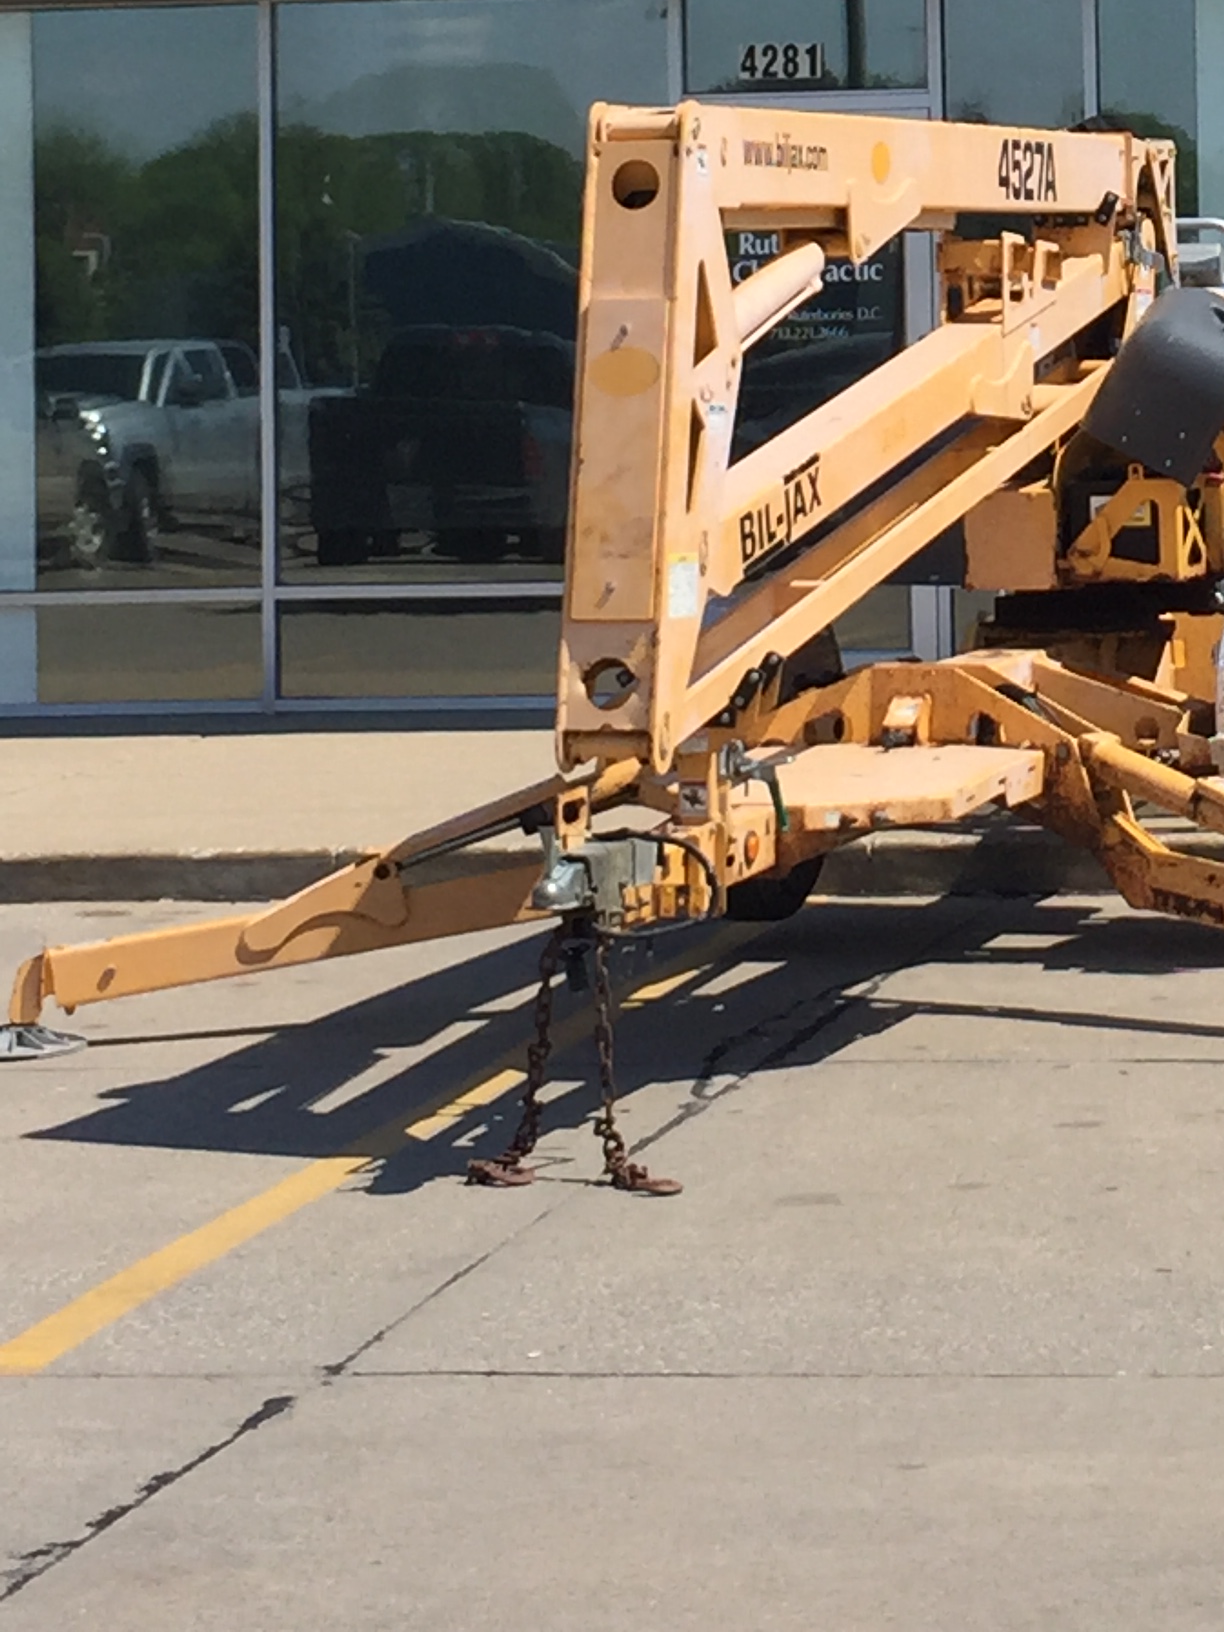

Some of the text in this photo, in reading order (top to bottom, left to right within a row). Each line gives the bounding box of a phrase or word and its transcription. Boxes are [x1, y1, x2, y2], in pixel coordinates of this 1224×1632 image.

[740, 43, 820, 78] 4281
[998, 138, 1058, 202] 4527A
[739, 466, 822, 564] BIL-JAX
